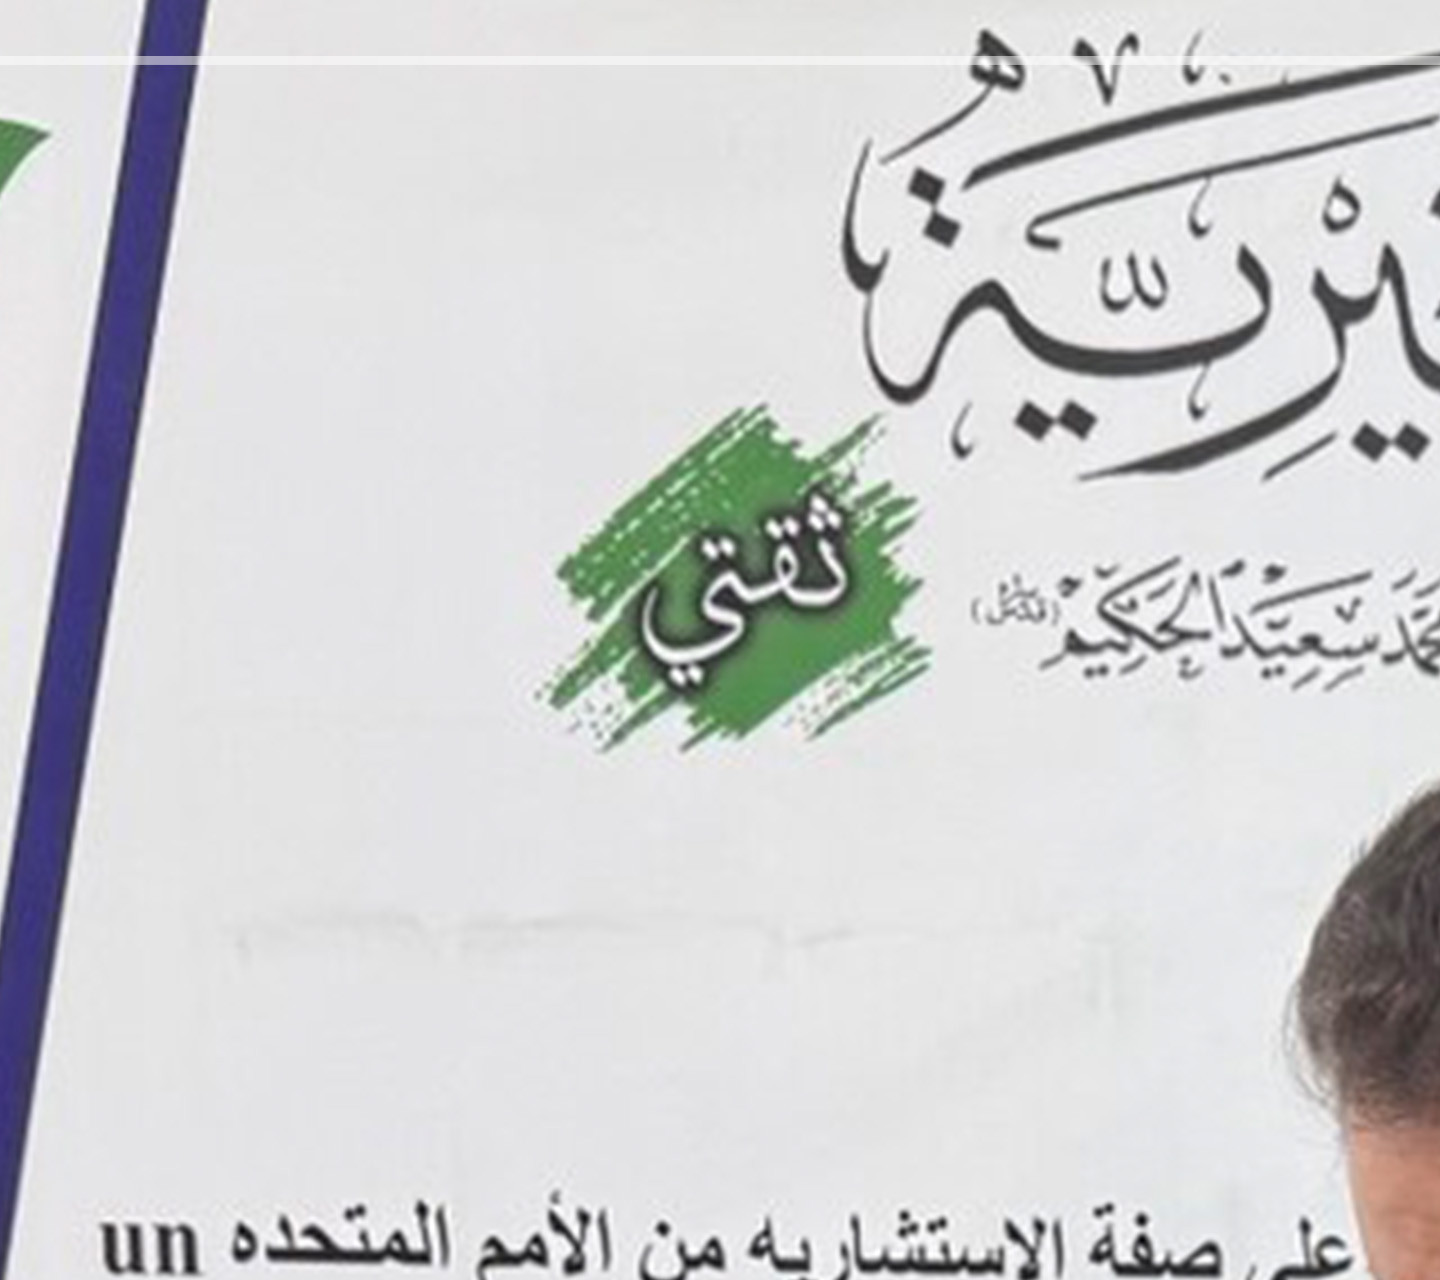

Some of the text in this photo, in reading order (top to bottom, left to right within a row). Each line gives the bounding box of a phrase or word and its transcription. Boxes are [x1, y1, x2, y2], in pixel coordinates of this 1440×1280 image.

[642, 492, 848, 687] ثقتي
[100, 1222, 203, 1276] un
[1088, 1202, 1223, 1279] صفة
